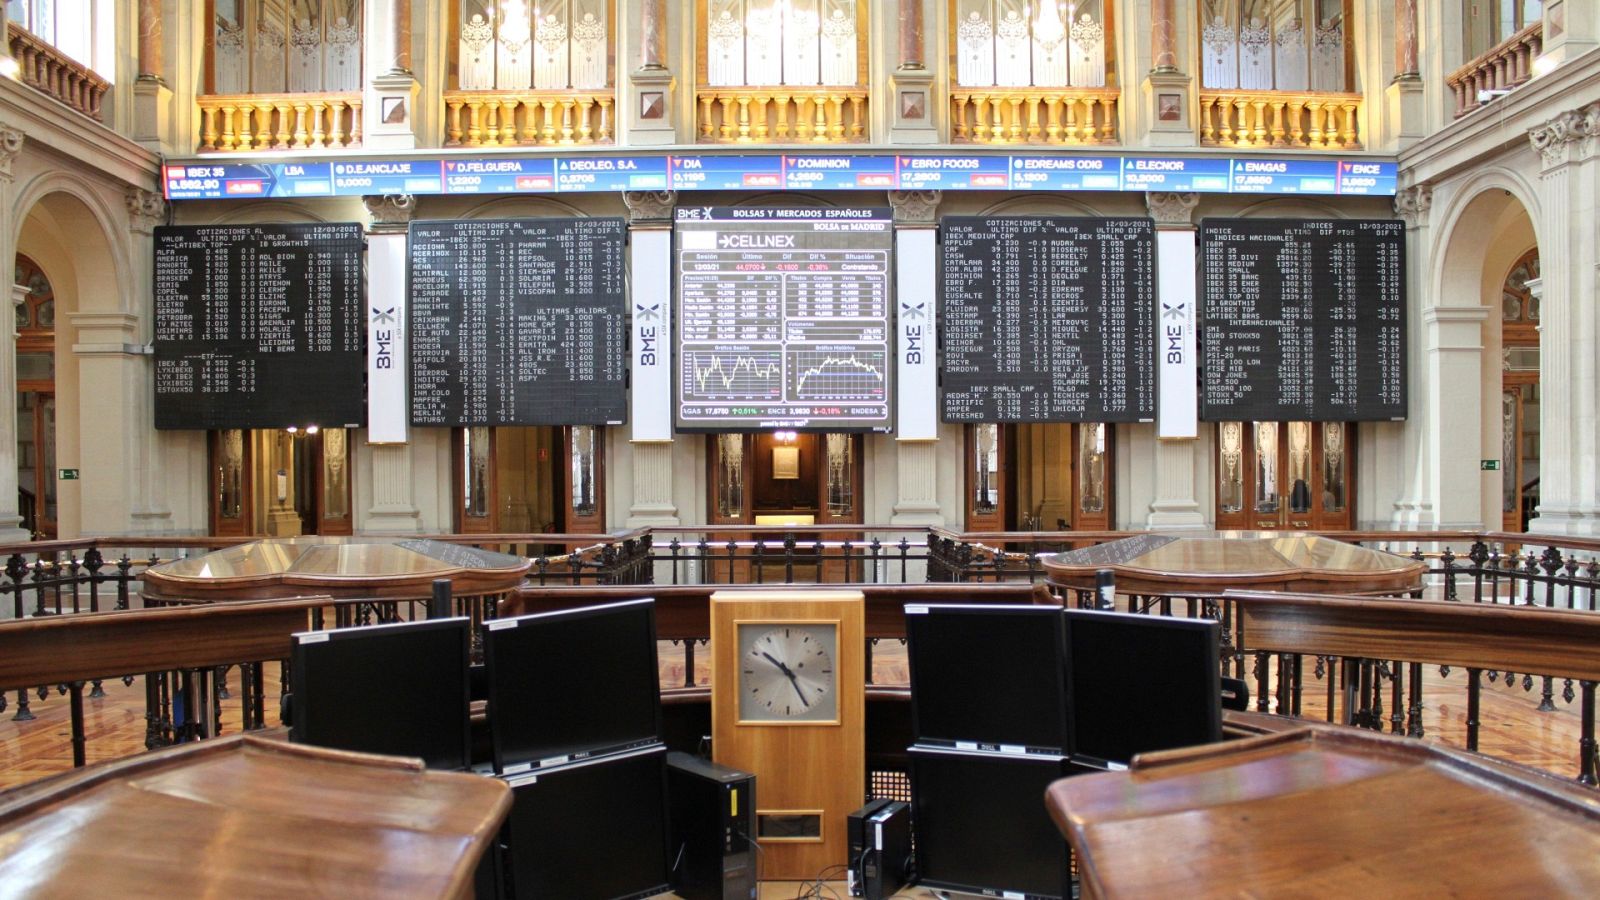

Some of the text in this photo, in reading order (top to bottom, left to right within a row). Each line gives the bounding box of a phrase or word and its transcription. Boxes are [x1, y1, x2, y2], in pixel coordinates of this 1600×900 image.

[457, 162, 522, 172] D.FELGUERA
[618, 160, 637, 170] S.A.
[683, 159, 701, 168] DIA
[798, 159, 850, 168] DOMINION
[912, 159, 979, 168] EBRO FOODS
[1025, 160, 1102, 169] EDREAMS ODIG
[1136, 161, 1184, 170] ELECNOR
[1245, 163, 1286, 172] ENAGAS
[188, 166, 224, 177] IBEX 35
[284, 166, 304, 176] LBA
[1353, 165, 1380, 174] ENCE
[678, 209, 700, 218] BME
[826, 209, 872, 217] ESPAÑOLES
[730, 235, 794, 247] CELLNEX
[641, 326, 655, 366] BME
[906, 325, 921, 364] BME
[1168, 325, 1181, 364] BME
[376, 330, 390, 369] BME
